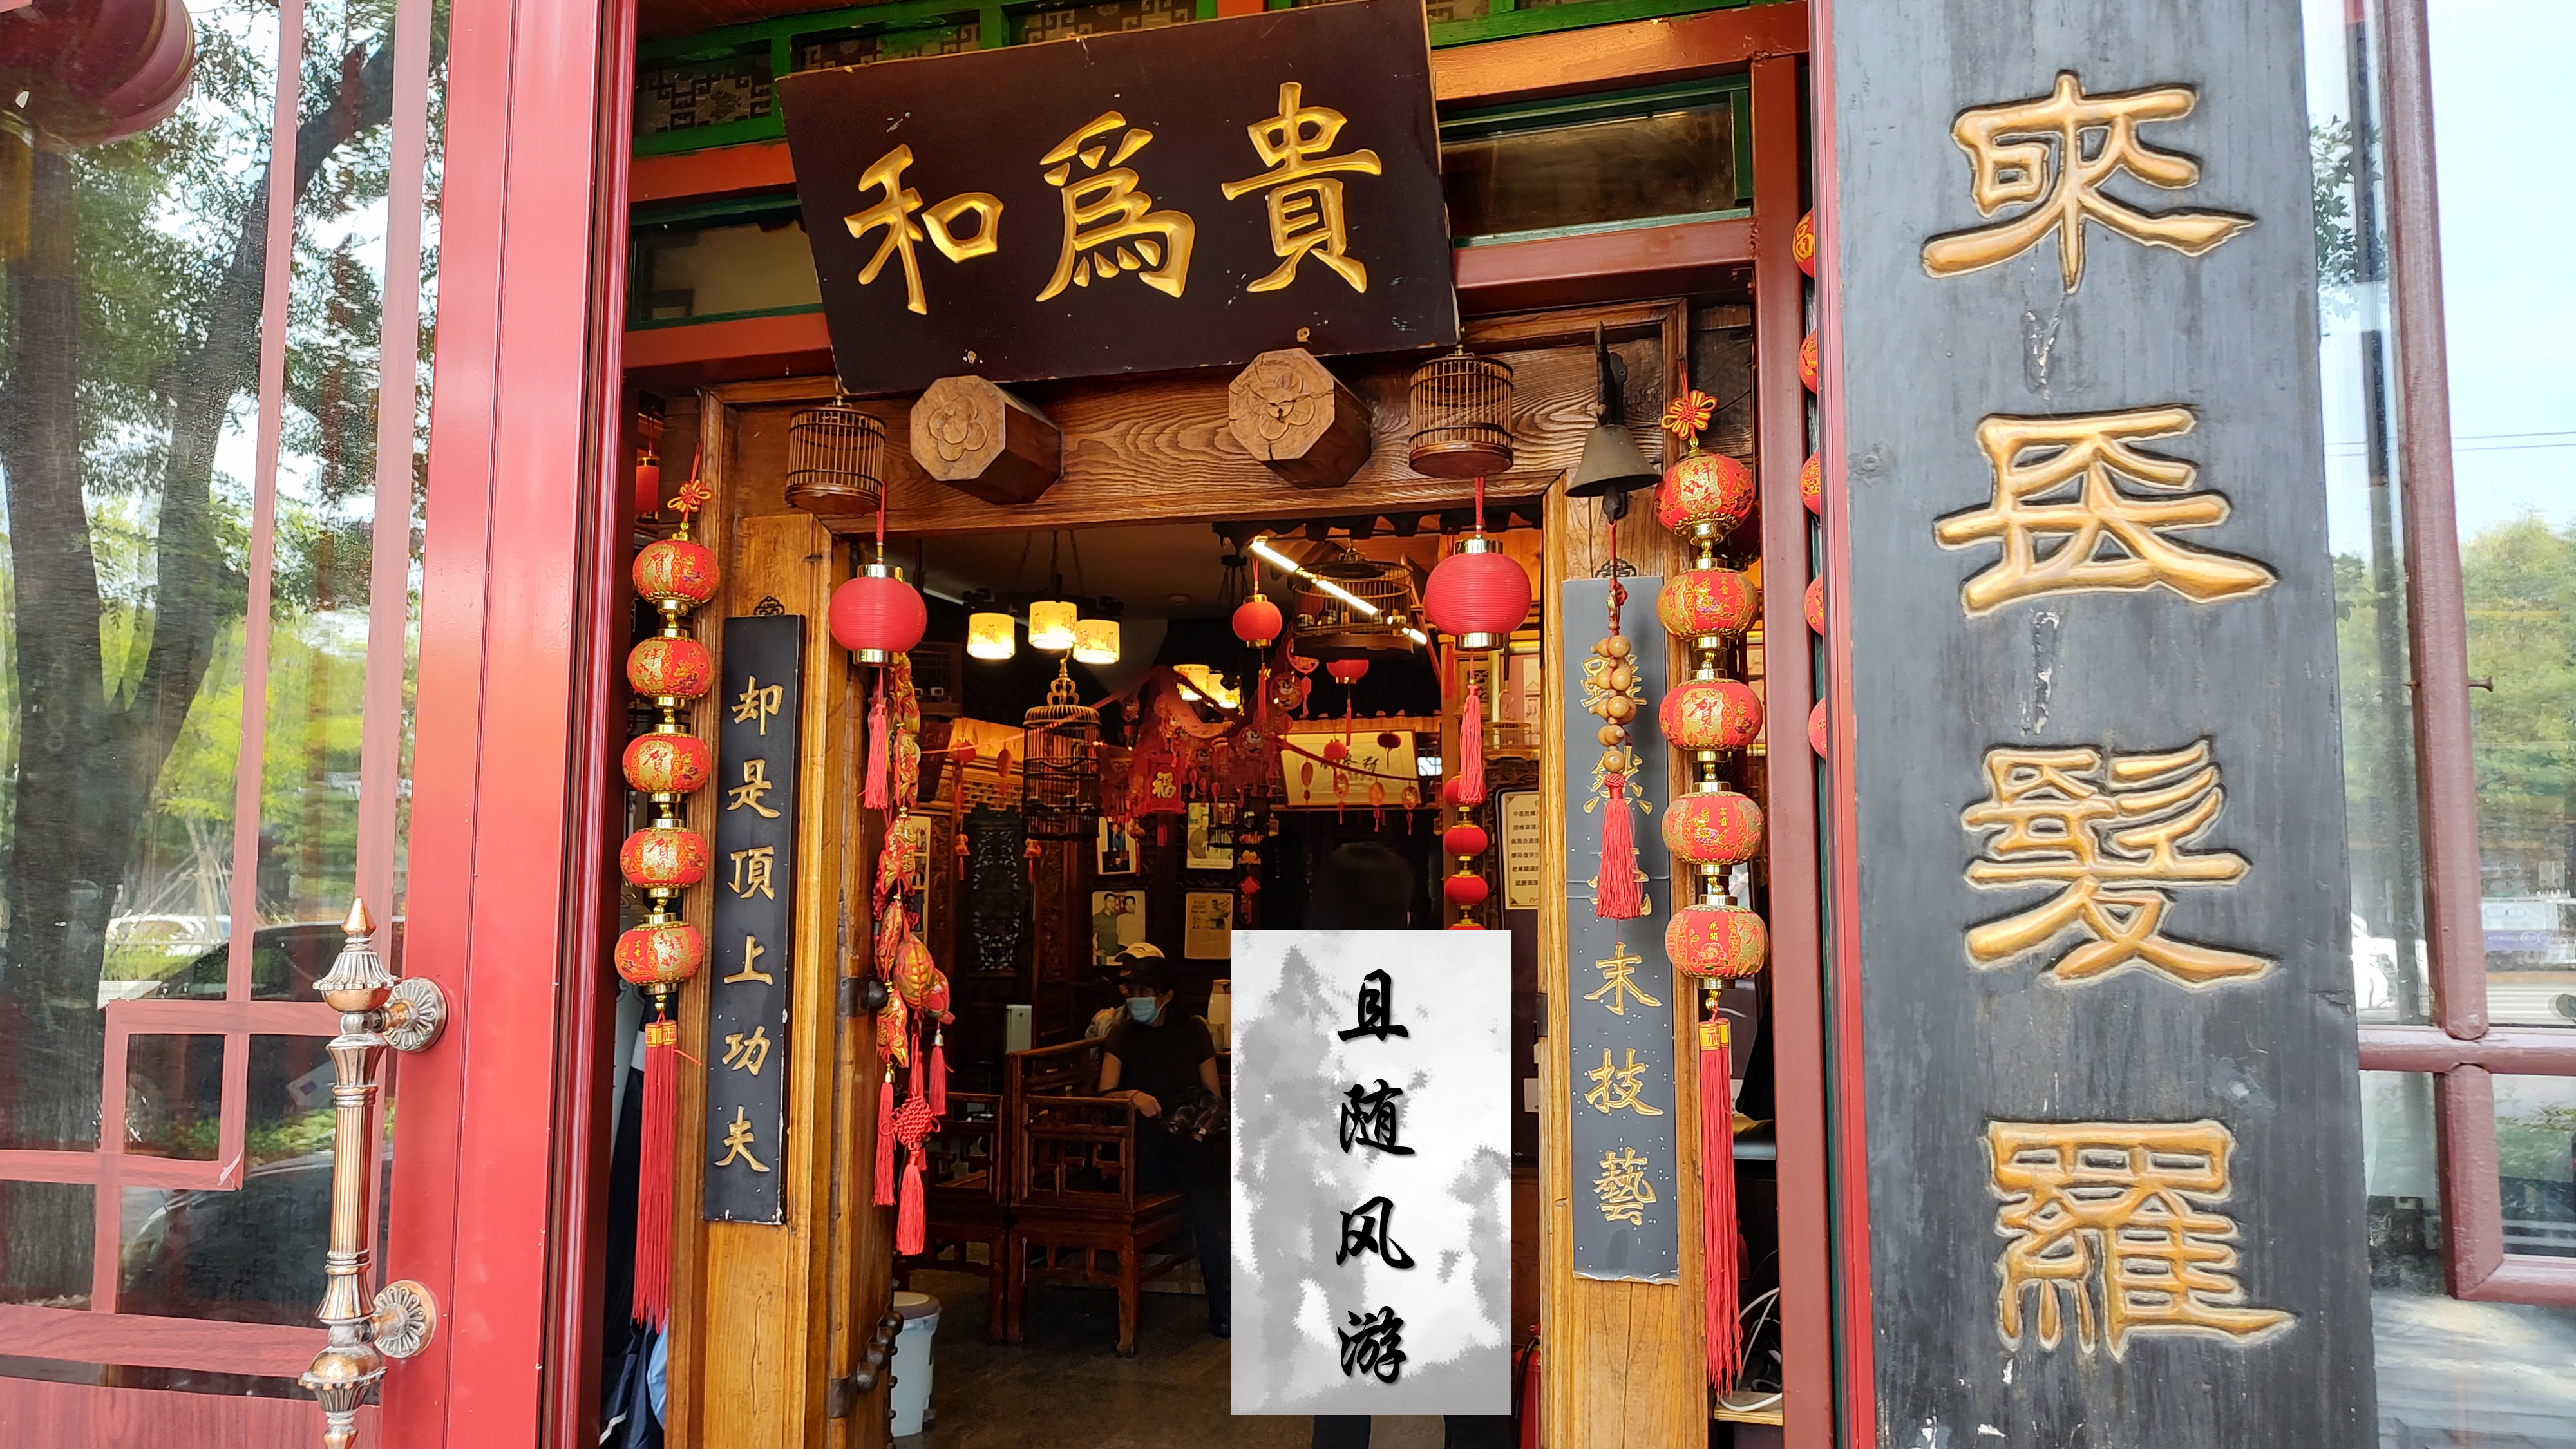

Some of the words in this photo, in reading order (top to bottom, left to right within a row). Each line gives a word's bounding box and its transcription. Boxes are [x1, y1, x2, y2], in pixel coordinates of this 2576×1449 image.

[712, 674, 784, 1174] 却是頂上功夫
[1152, 772, 1176, 798] 福
[1580, 654, 1663, 1226] 雖然末技藝
